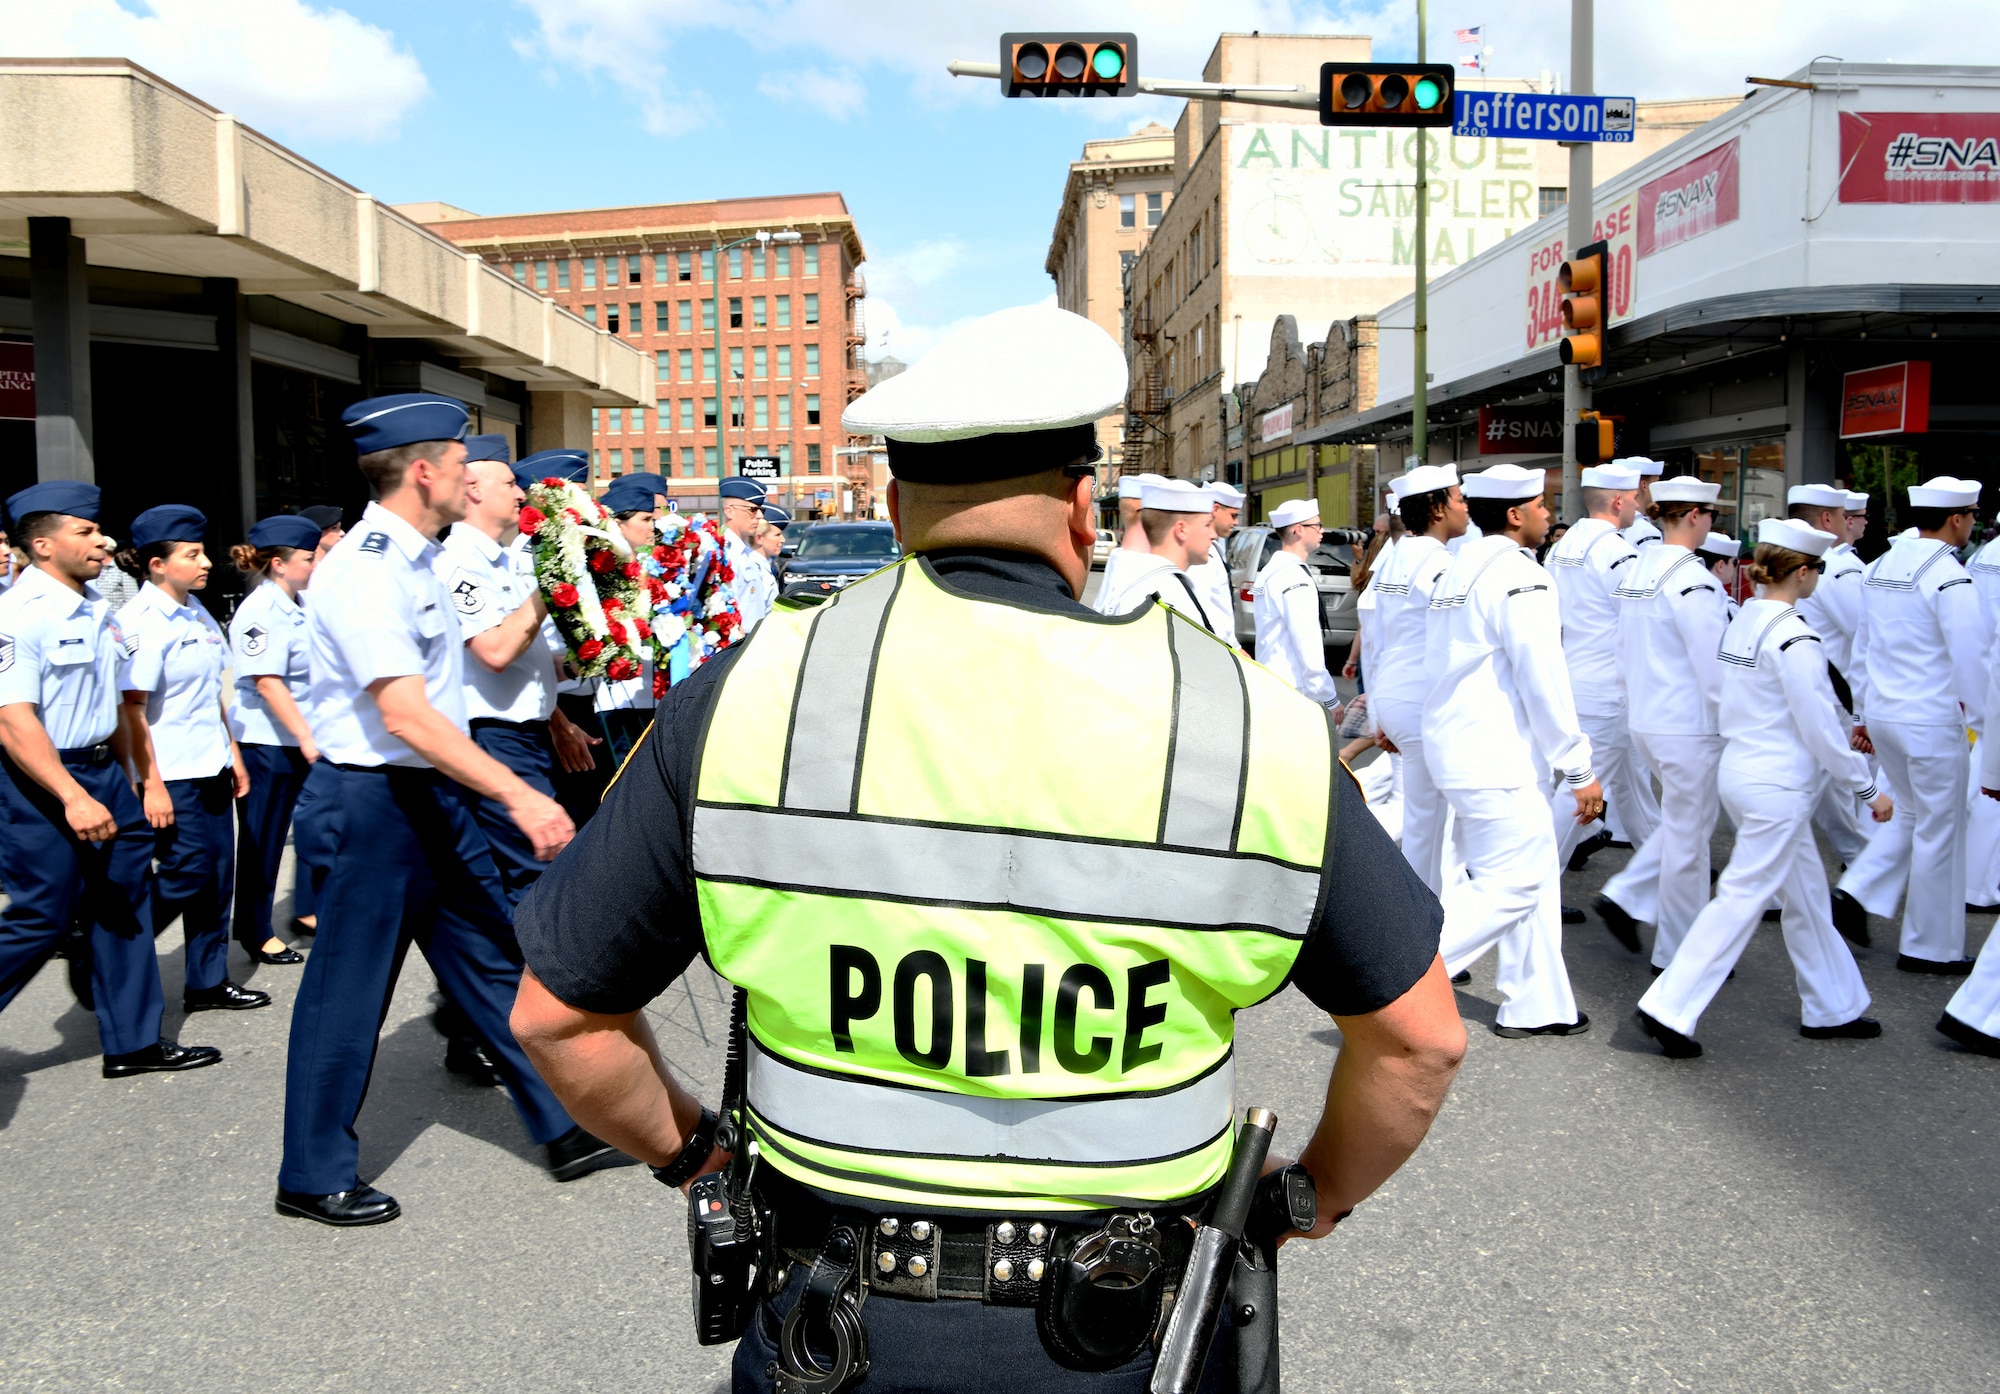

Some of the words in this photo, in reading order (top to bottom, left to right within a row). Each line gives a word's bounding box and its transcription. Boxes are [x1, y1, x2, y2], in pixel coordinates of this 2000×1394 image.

[1458, 93, 1599, 132] Jefferson
[1463, 127, 1488, 137] 200
[1237, 127, 1533, 175] ANTIQUE
[1598, 132, 1623, 141] 100
[1886, 134, 2000, 168] #SNA
[1338, 177, 1533, 219] SAMPLER
[1656, 171, 1718, 222] #SNAX
[1391, 226, 1512, 265] MAL
[1530, 240, 1564, 277] FOR
[1592, 203, 1632, 243] ASE
[1846, 386, 1902, 412] #SNAX
[742, 467, 777, 478] Parking
[745, 459, 773, 468] Public
[830, 944, 1171, 1077] POLICE
